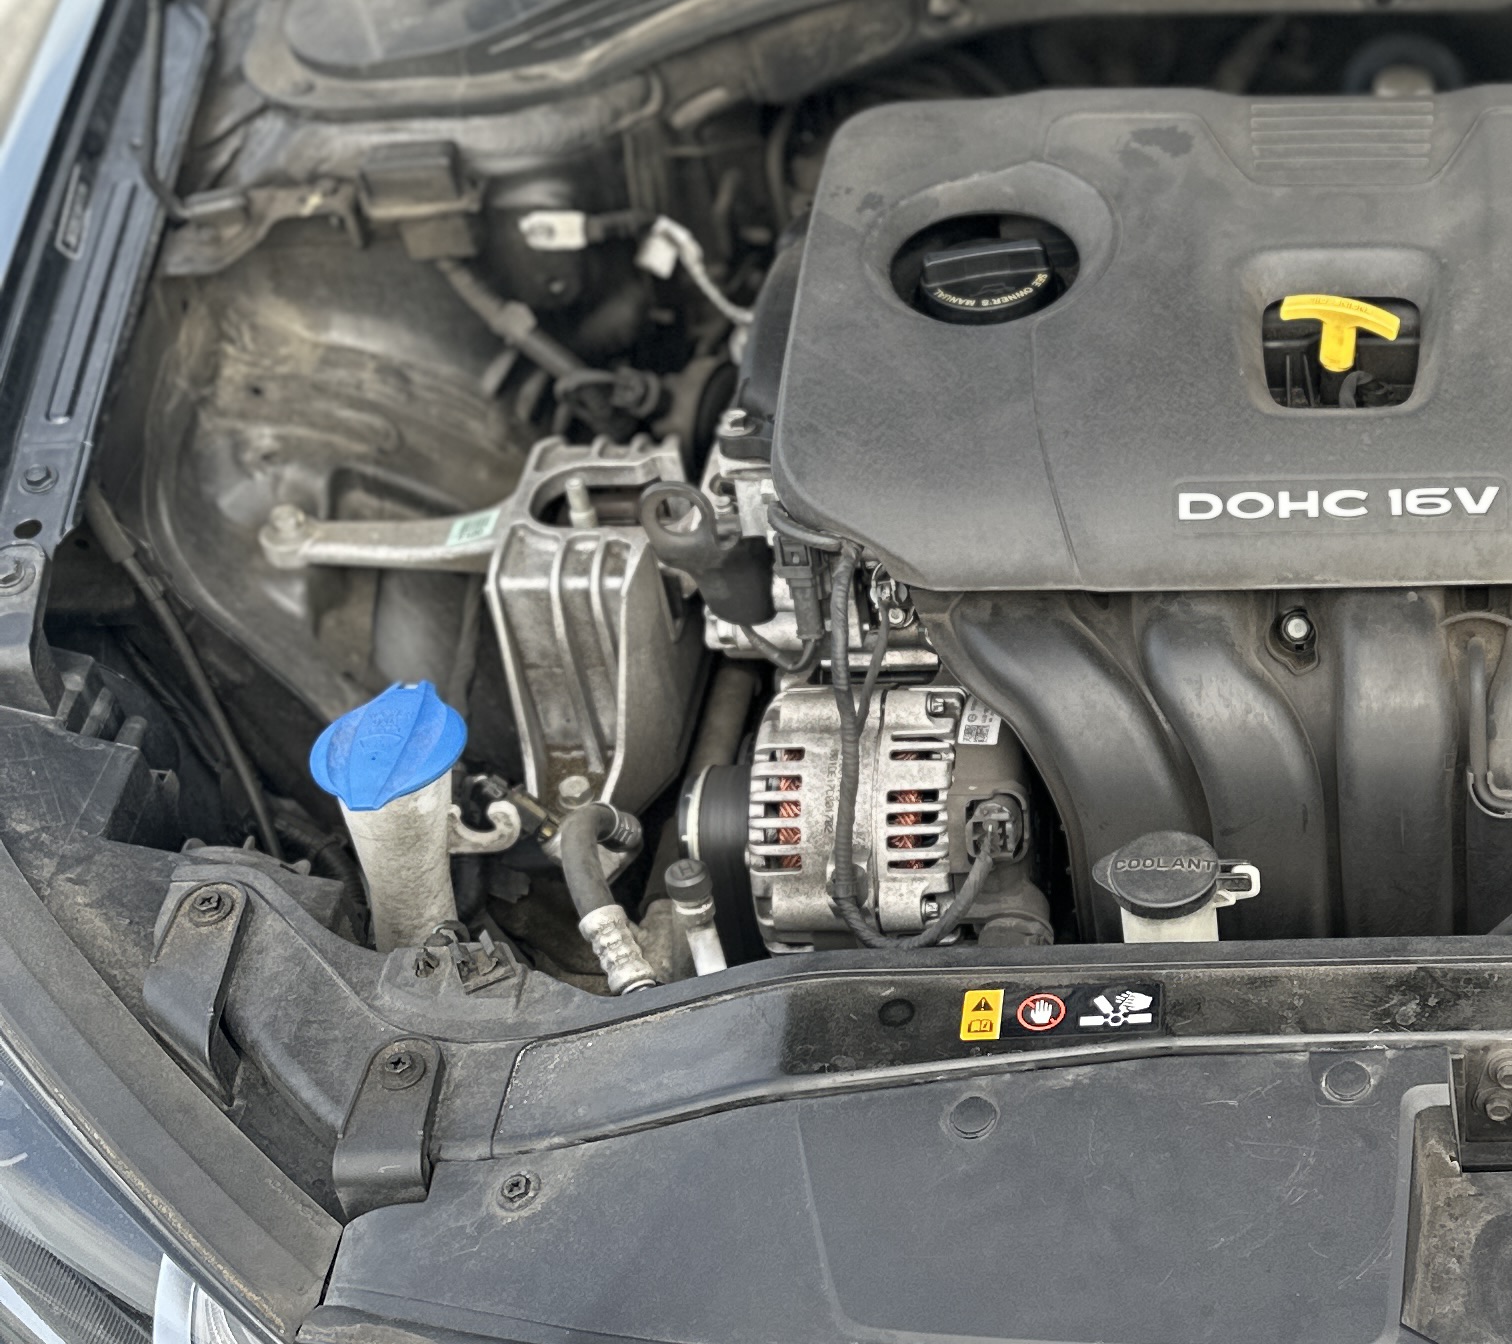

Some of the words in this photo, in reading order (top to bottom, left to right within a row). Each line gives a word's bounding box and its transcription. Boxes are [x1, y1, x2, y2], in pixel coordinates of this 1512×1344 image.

[1031, 272, 1048, 288] SEE
[933, 287, 976, 307] MANUAL
[1178, 489, 1369, 520] DOHC
[1388, 486, 1500, 517] 16V
[1114, 857, 1217, 872] COOLANT
